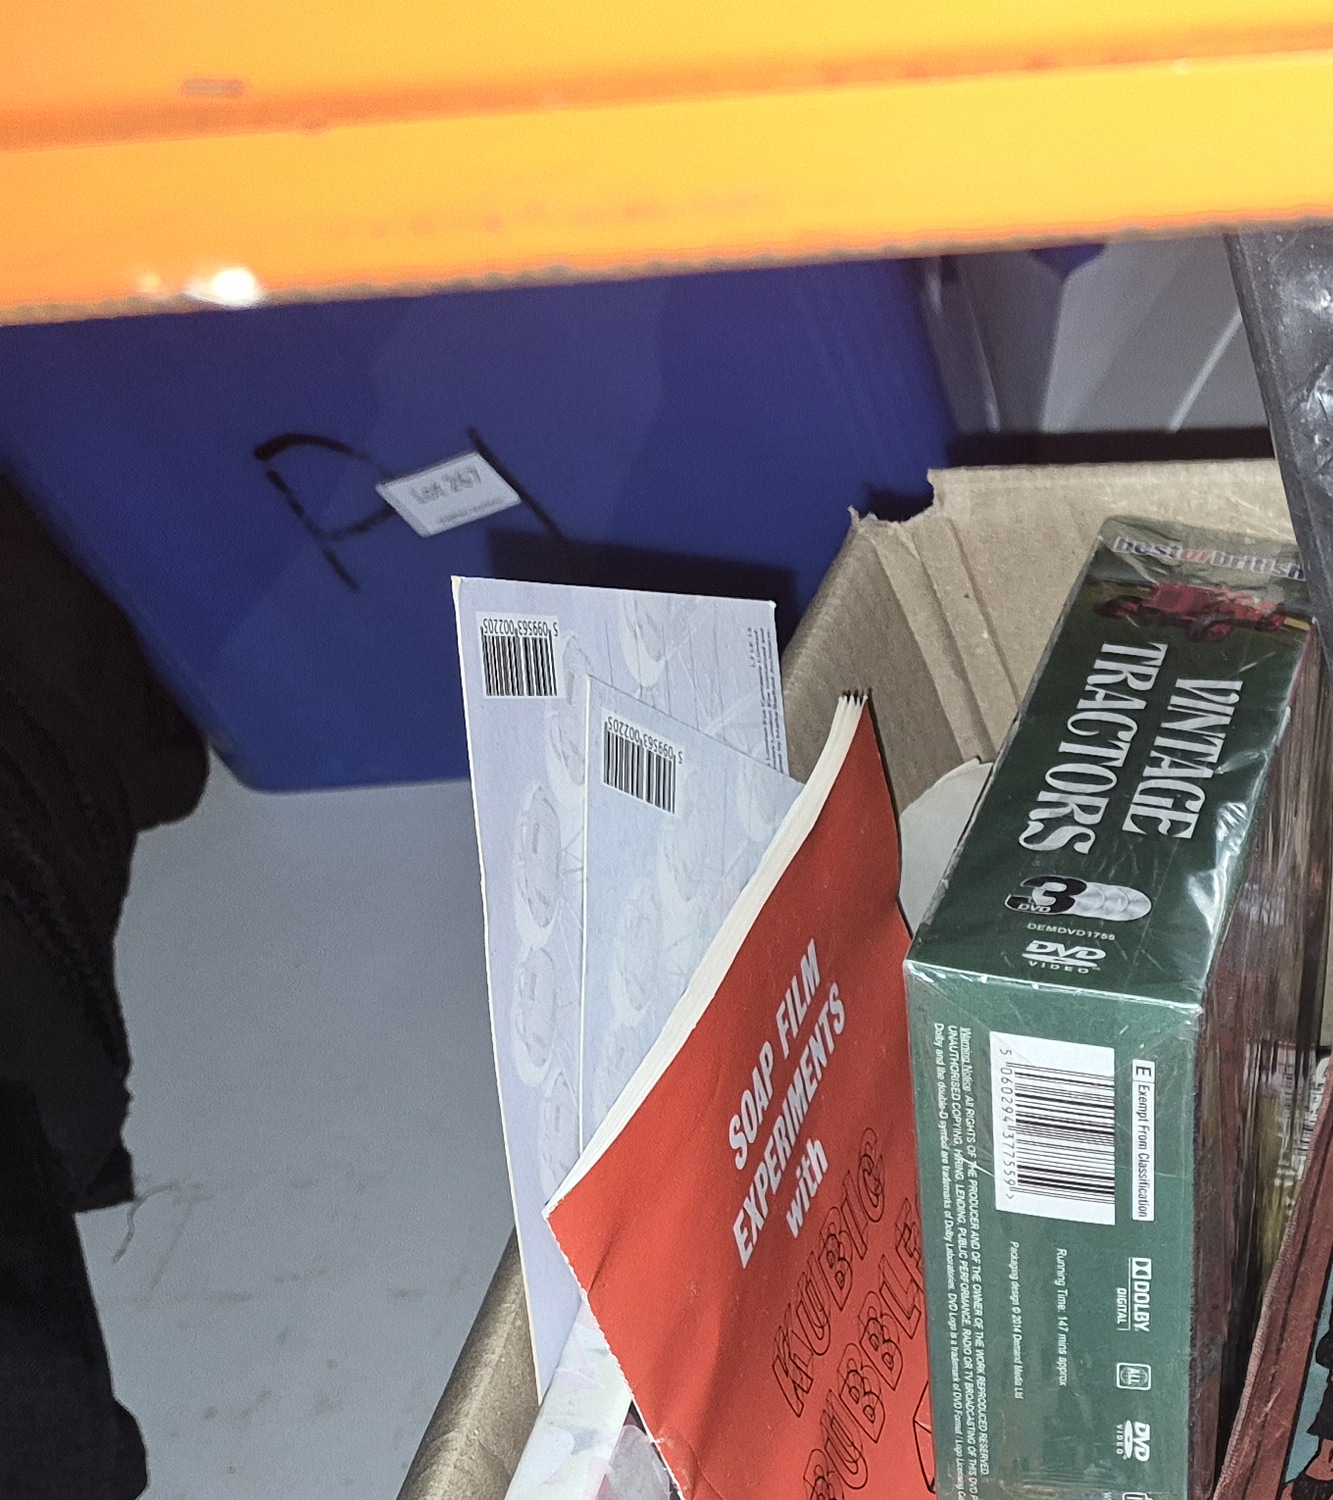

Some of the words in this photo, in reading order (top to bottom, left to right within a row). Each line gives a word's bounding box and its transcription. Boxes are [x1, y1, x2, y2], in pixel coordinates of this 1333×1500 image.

[1018, 641, 1169, 855] TRACTORS
[1121, 678, 1244, 840] VINTAGE
[1029, 960, 1090, 975] VIDEO
[729, 1041, 773, 1171] SOAP
[776, 937, 821, 1057] FILM
[1000, 1048, 1012, 1057] 5
[1135, 1065, 1151, 1077] E
[1000, 1067, 1015, 1123] 060294
[1136, 1084, 1150, 1124] Exempt
[733, 981, 846, 1269] EXPERIMENTS
[1136, 1125, 1150, 1151] From
[1001, 1130, 1016, 1188] 377559
[784, 1136, 829, 1239] with
[1137, 1152, 1150, 1218] Classification
[1054, 1248, 1068, 1287] Running
[1056, 1288, 1068, 1312] Time:
[1116, 1287, 1127, 1325] DIGITAL
[1133, 1281, 1150, 1332] DOLBY
[1057, 1316, 1068, 1331] 147
[1012, 1334, 1022, 1367] Demand
[1057, 1333, 1069, 1356] mins
[1056, 1357, 1068, 1387] approx
[1115, 1423, 1123, 1456] VIDEO
[1133, 1421, 1151, 1463] DVD
